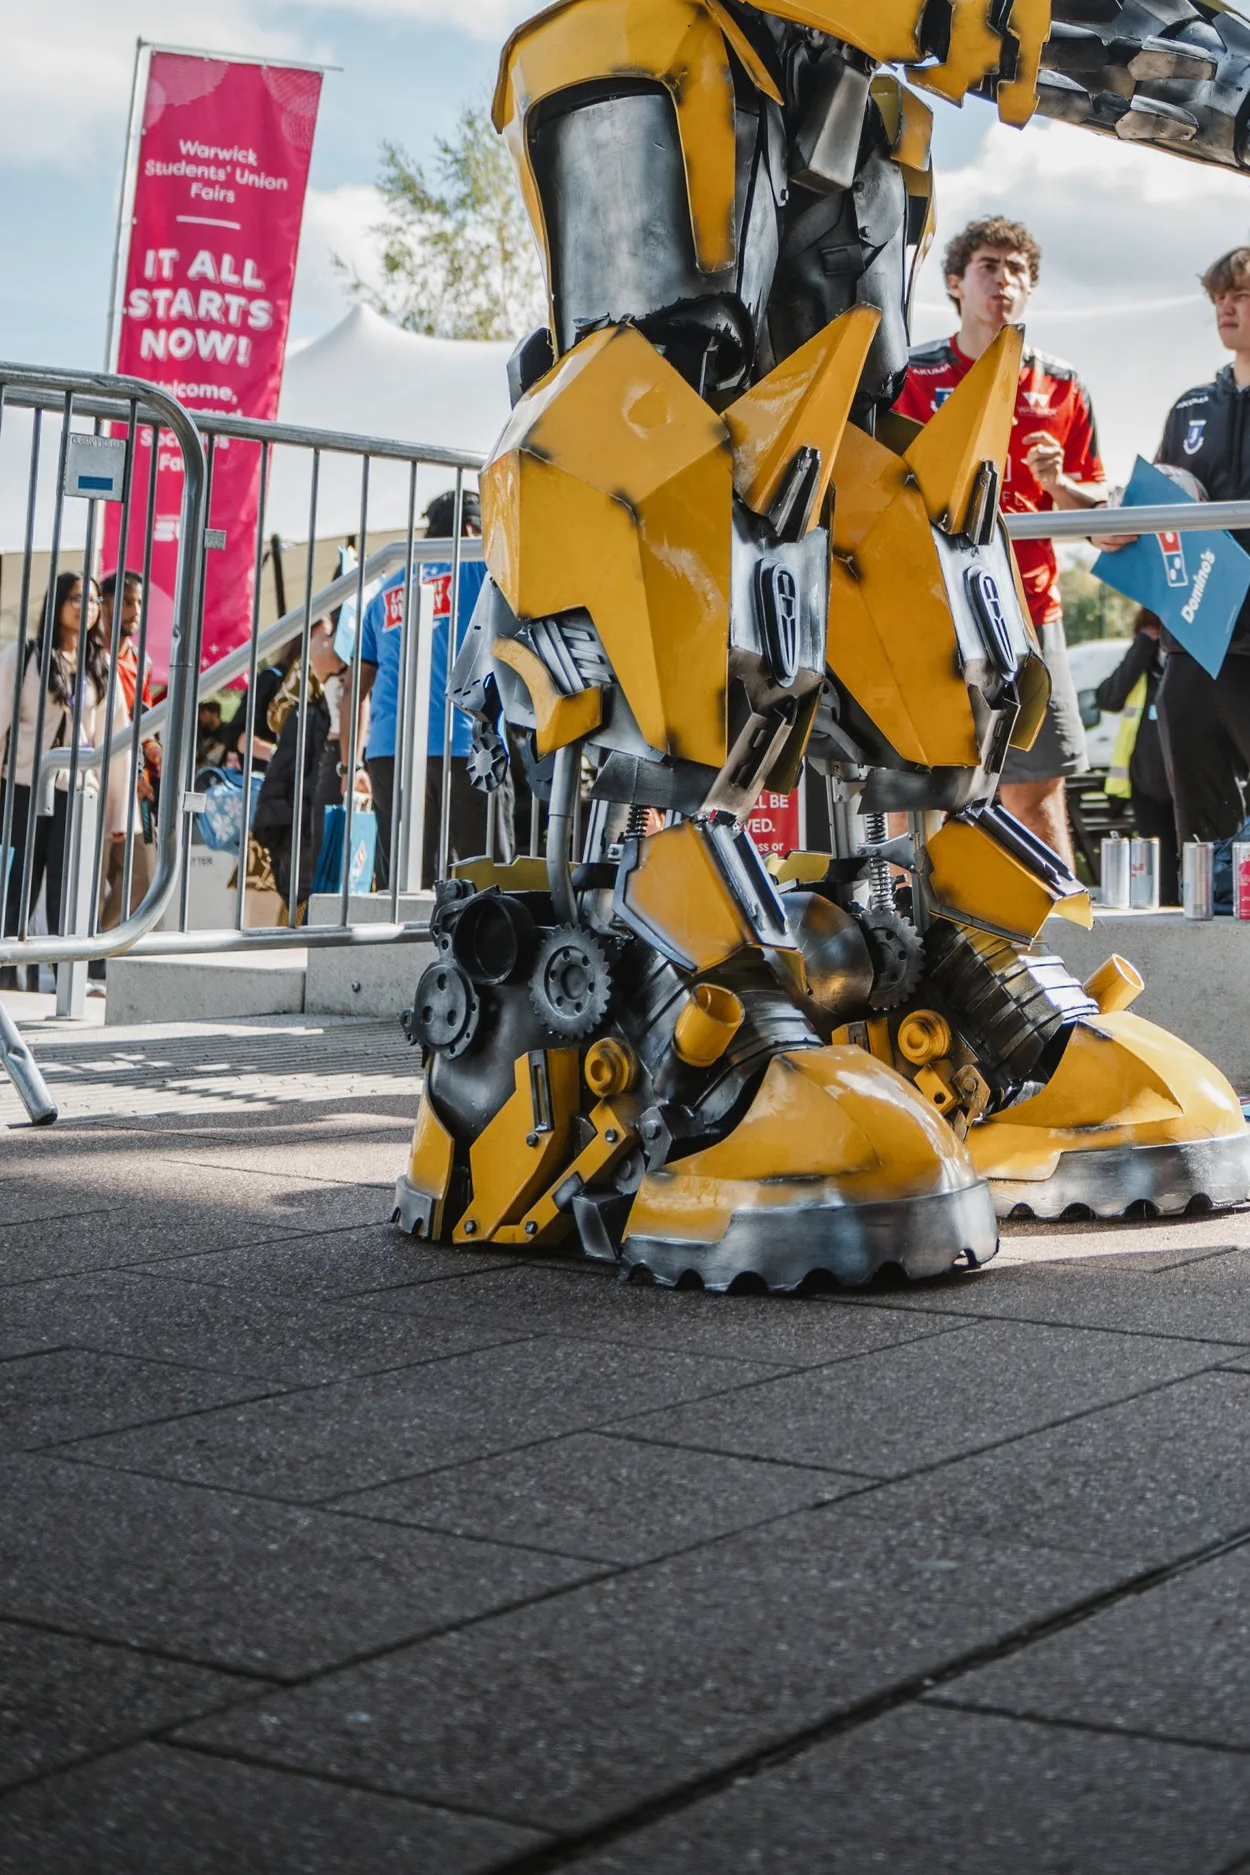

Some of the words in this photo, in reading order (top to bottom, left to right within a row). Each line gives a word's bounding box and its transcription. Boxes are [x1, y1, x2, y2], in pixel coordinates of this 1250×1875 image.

[179, 139, 258, 167] Warwick
[145, 159, 232, 182] Students'
[235, 168, 288, 191] Union
[190, 182, 235, 204] Fairs
[144, 248, 179, 280] IT
[187, 250, 265, 291] ALL
[128, 288, 272, 331] STARTS
[140, 327, 252, 368] NOW!
[1181, 547, 1216, 624] Domino's
[769, 794, 789, 809] BE
[743, 818, 776, 833] VED.
